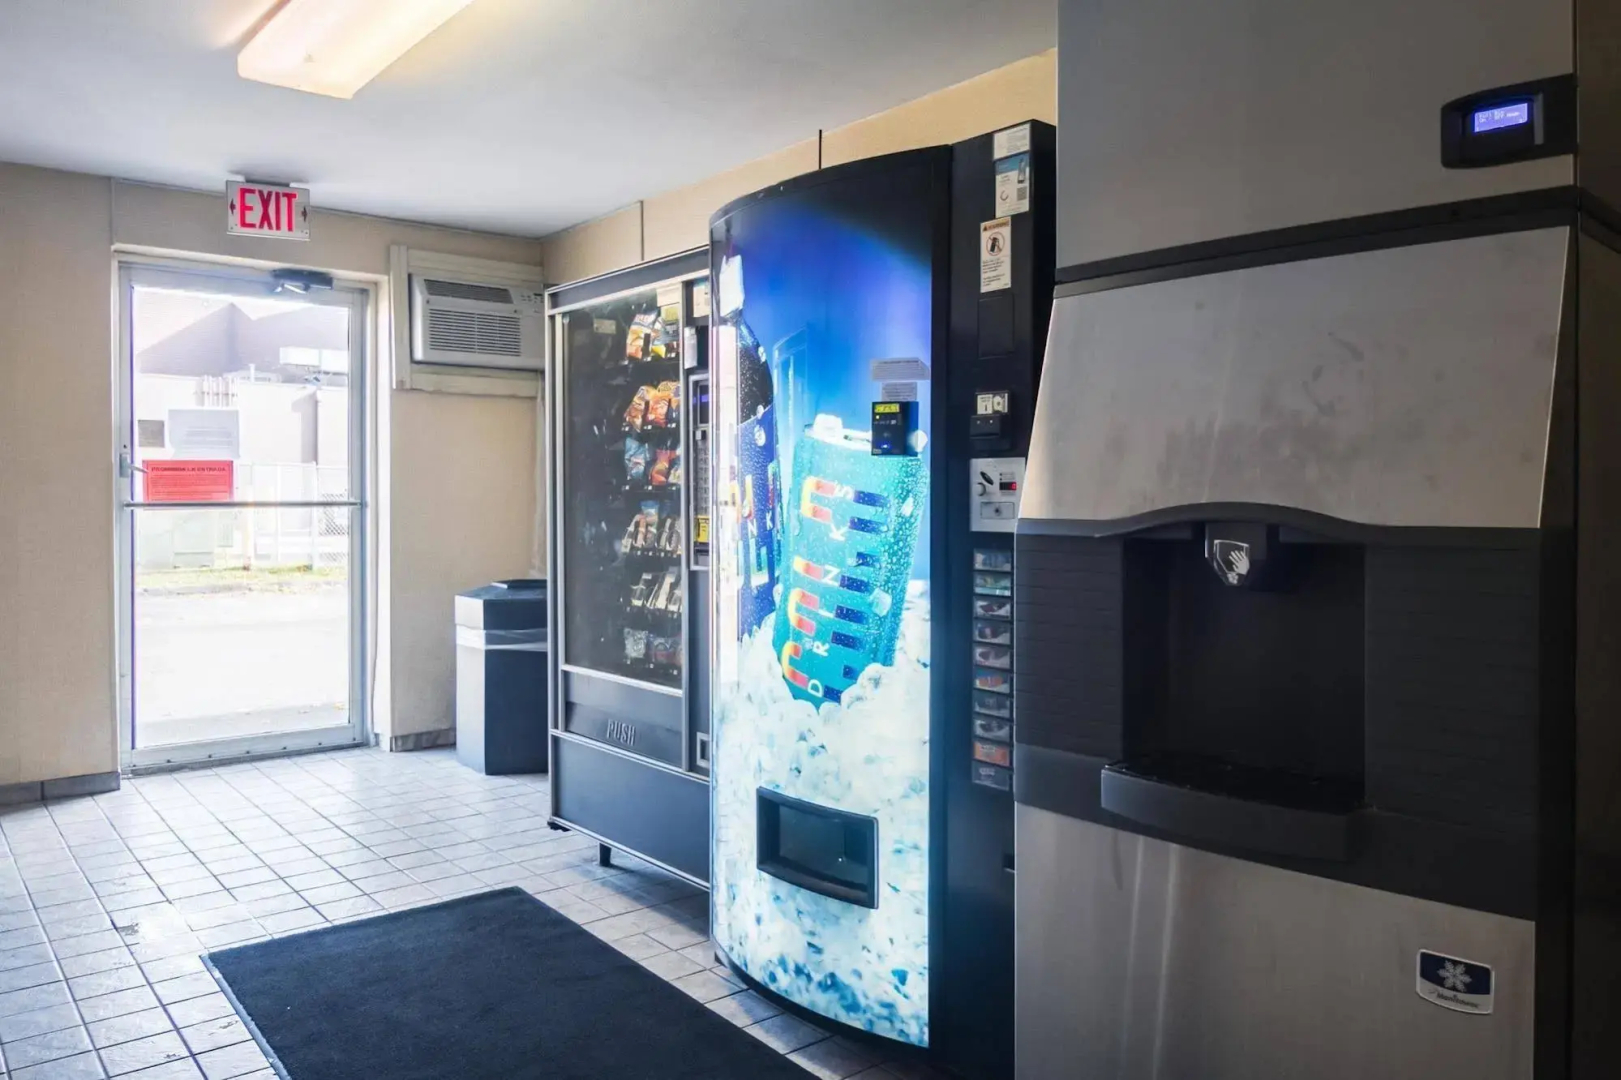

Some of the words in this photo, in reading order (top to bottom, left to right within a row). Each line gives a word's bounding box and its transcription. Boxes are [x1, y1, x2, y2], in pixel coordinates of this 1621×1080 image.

[239, 187, 297, 232] EXIT
[806, 482, 855, 698] DRINKS
[606, 719, 635, 747] PUSH
